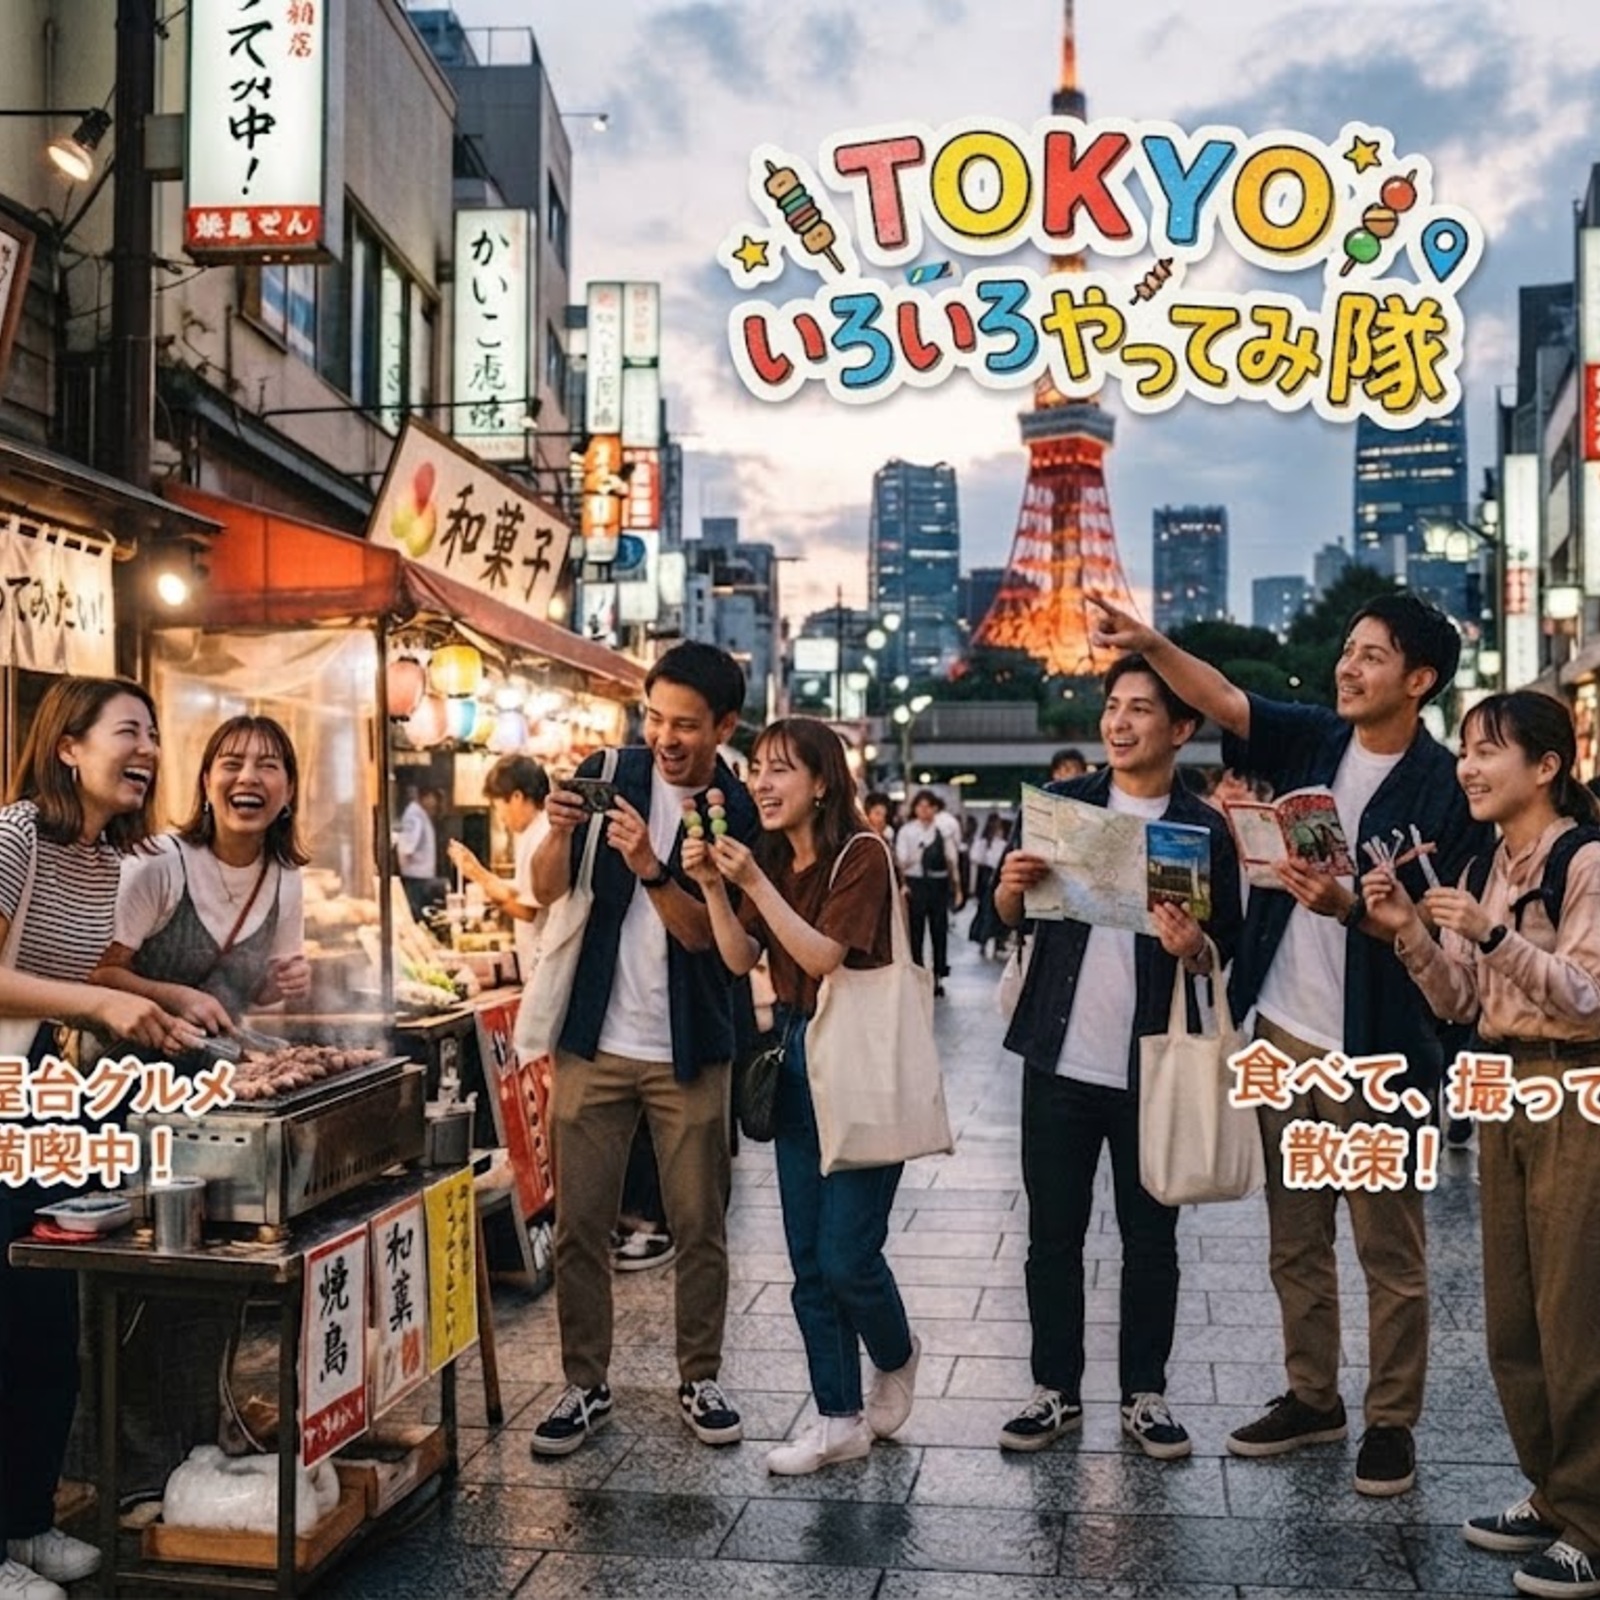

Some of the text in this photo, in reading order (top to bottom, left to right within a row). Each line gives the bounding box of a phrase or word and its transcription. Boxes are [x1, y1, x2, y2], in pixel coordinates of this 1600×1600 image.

[440, 483, 554, 602] 和菓子
[319, 1254, 350, 1384] 焼鳥
